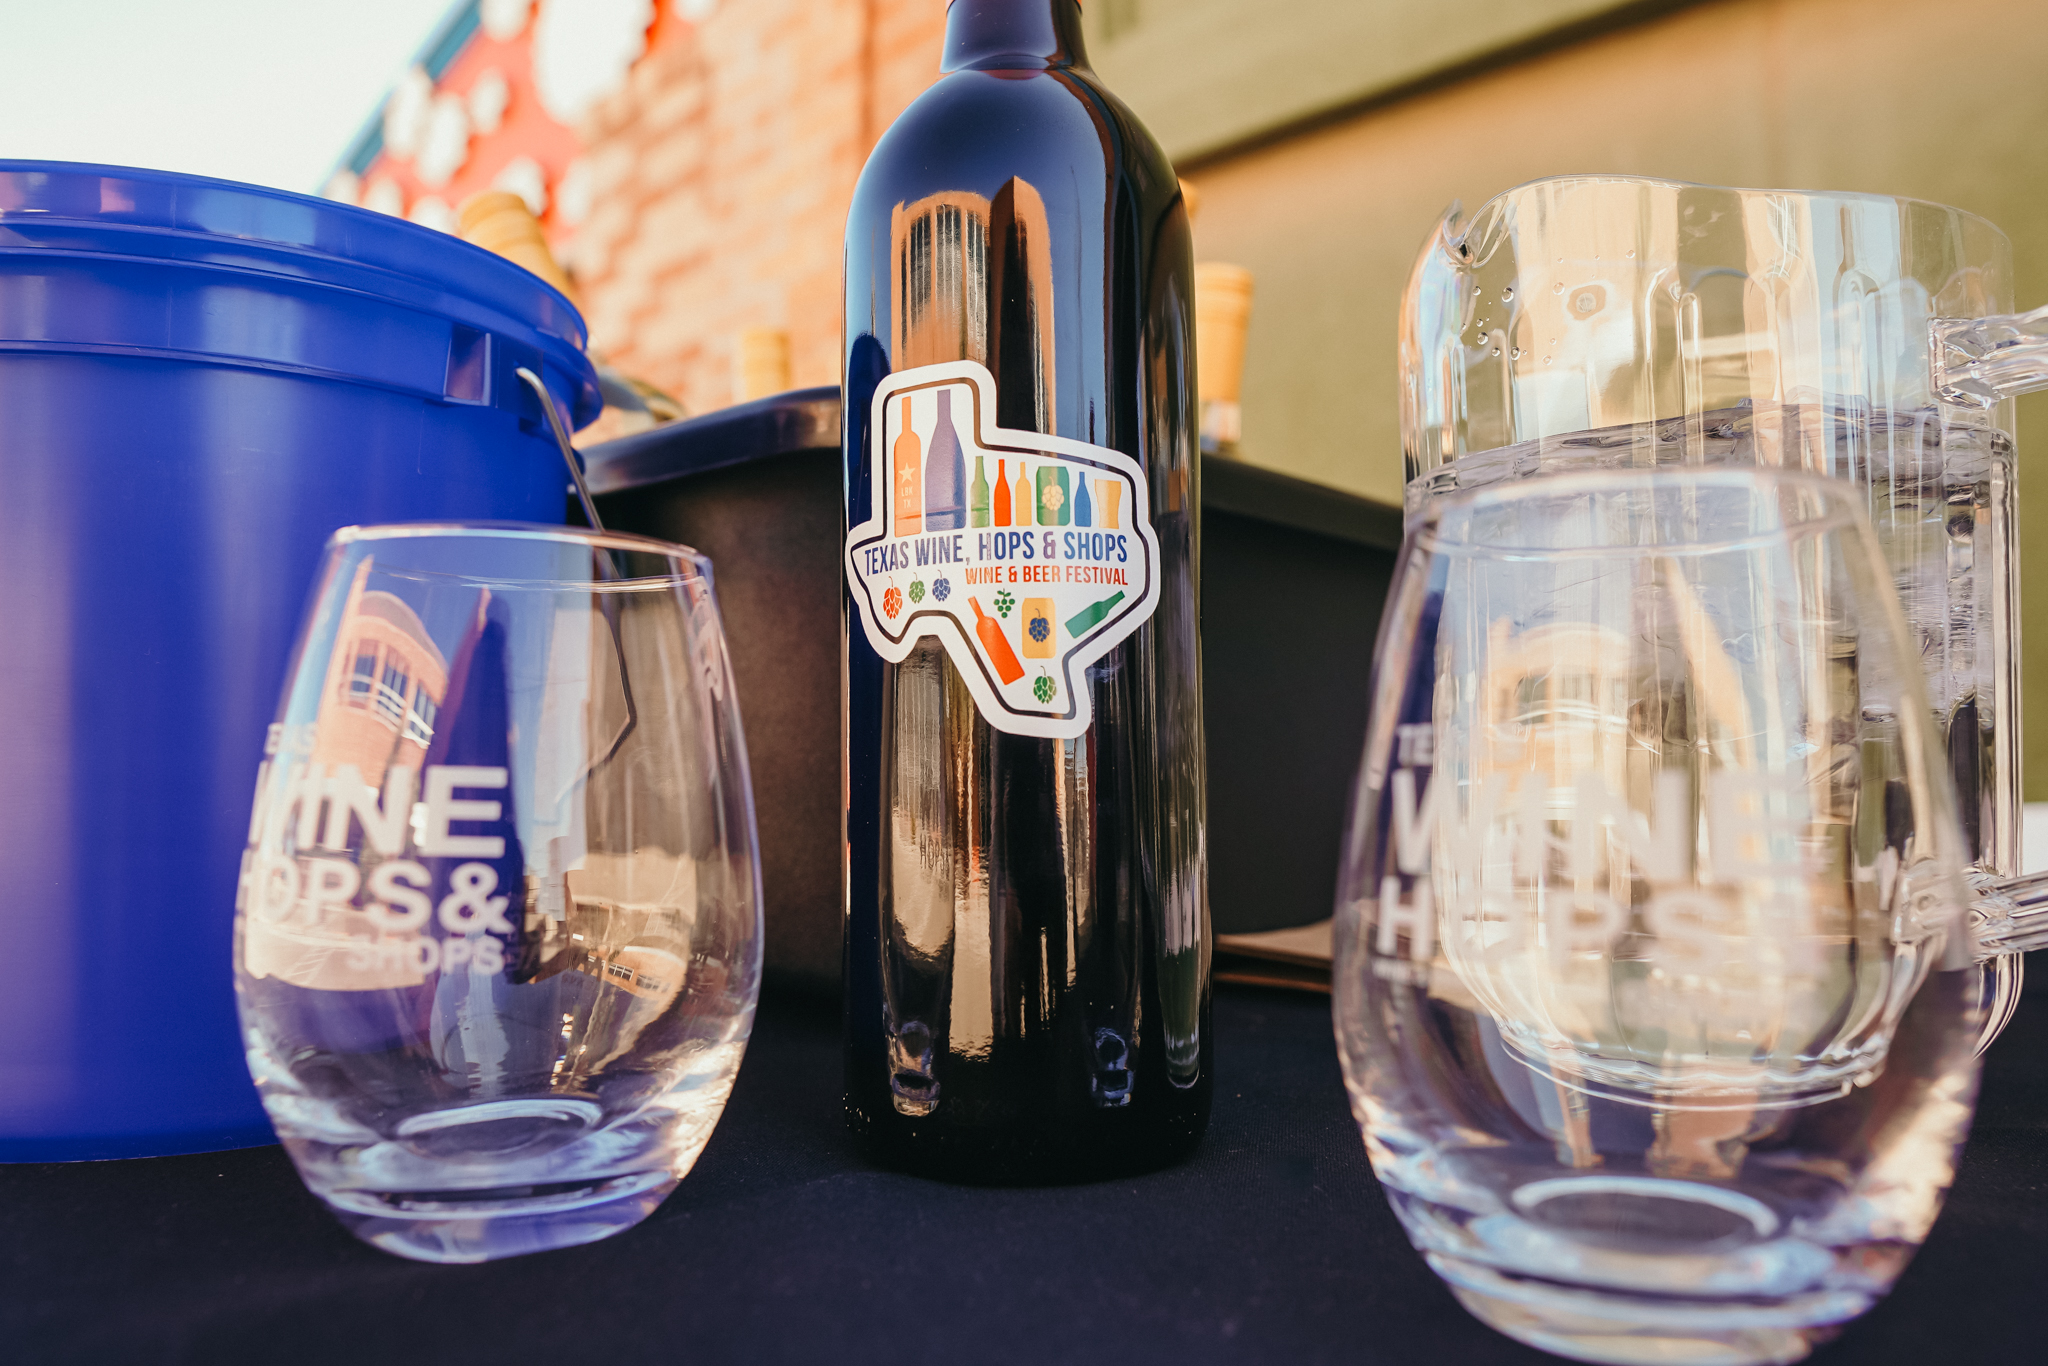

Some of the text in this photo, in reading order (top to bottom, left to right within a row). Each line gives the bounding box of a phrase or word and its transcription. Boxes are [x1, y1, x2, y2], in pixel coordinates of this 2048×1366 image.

[901, 486, 913, 497] LBK
[903, 499, 912, 509] TX
[864, 531, 1127, 576] TEXAS WINE, HOPS & SHOPS
[965, 565, 1128, 585] WINE & BEER FESTIVAL
